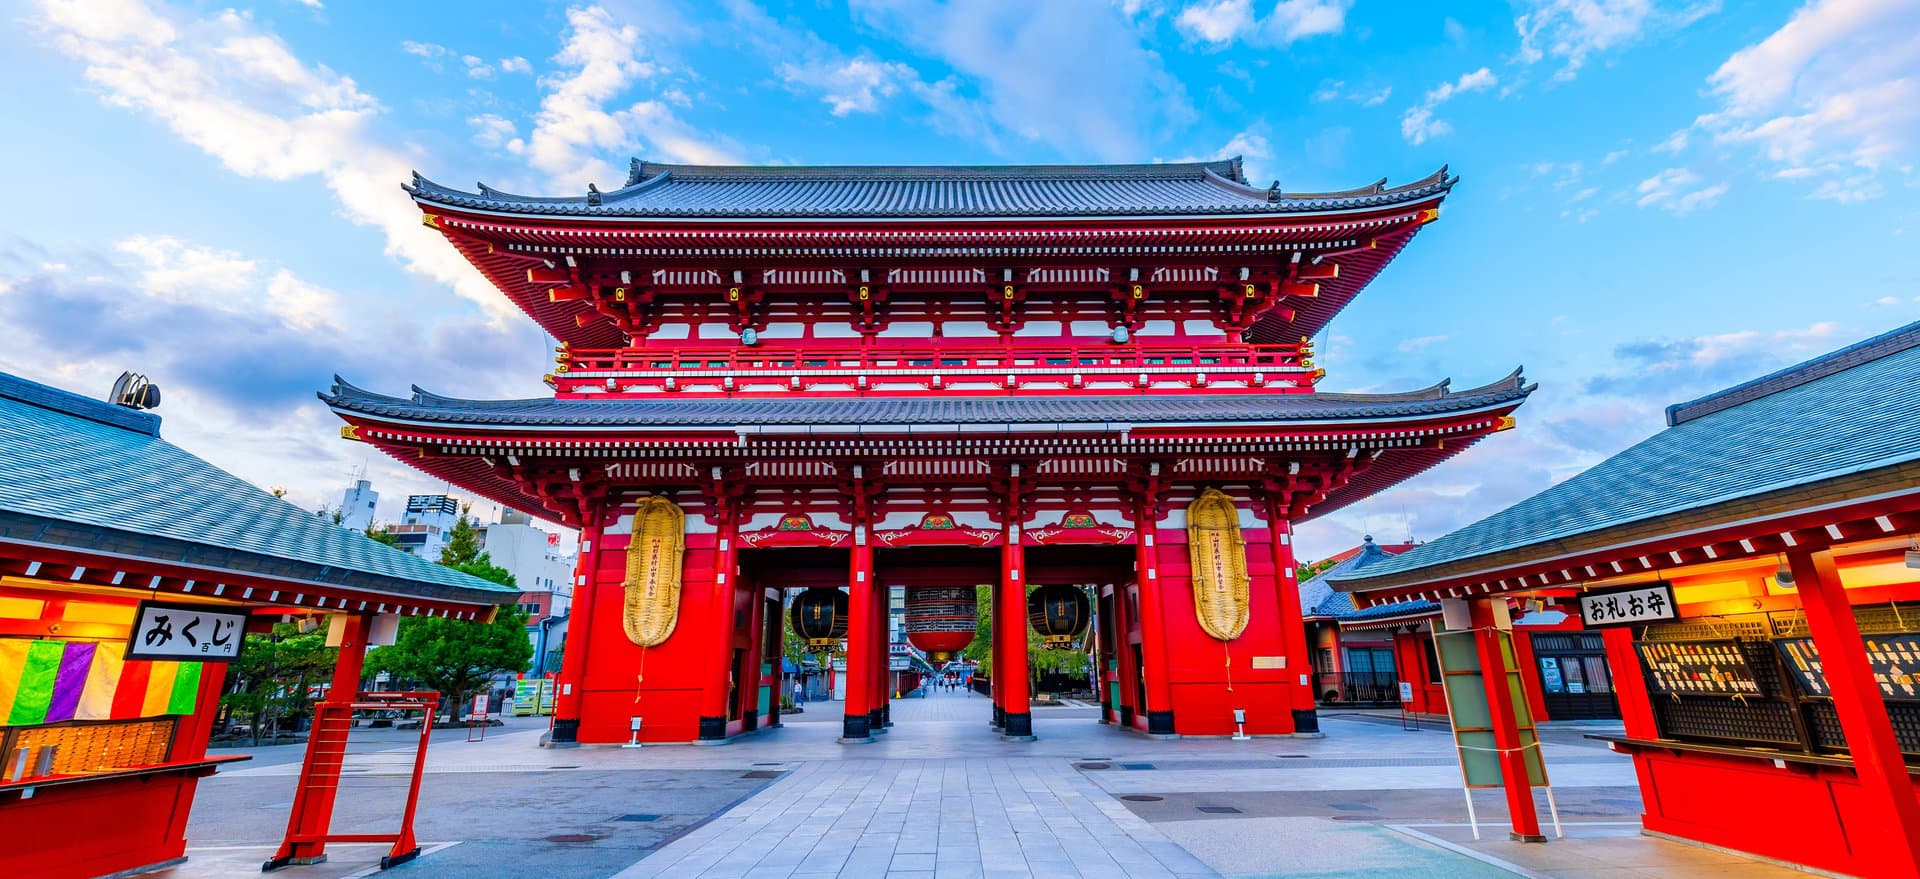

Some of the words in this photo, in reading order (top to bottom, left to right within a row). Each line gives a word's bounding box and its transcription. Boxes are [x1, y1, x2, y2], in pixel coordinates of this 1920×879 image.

[1590, 591, 1665, 621] お札お守
[146, 615, 234, 647] みくじ
